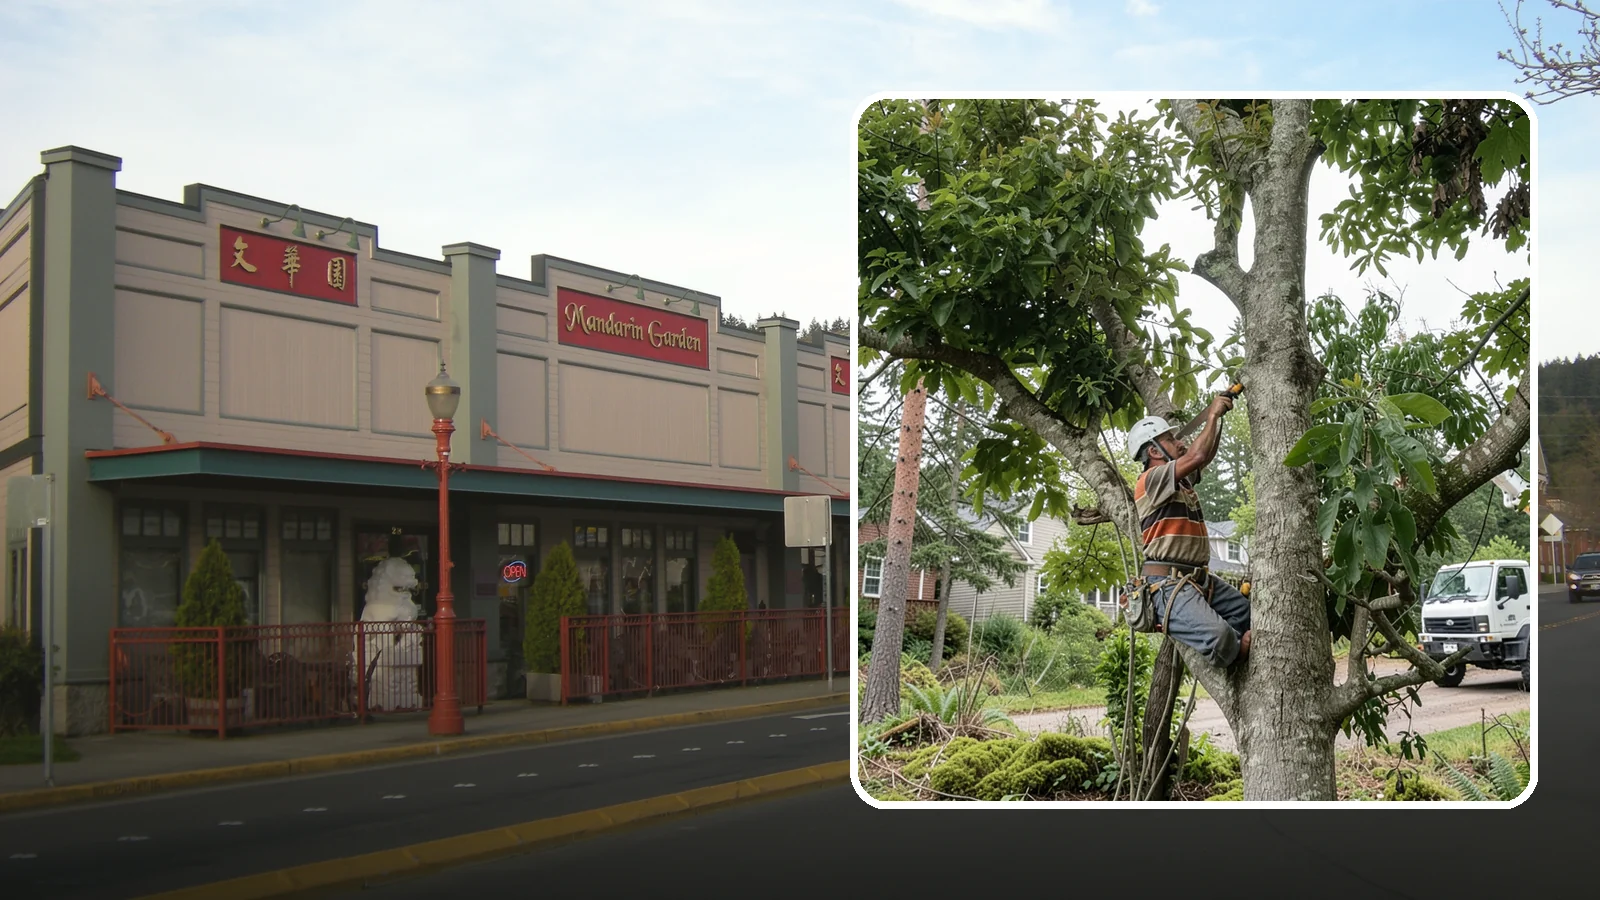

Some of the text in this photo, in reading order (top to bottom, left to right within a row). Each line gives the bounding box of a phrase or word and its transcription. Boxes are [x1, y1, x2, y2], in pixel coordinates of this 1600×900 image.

[564, 302, 701, 352] Mandarin Garden
[503, 565, 527, 578] OPEN
